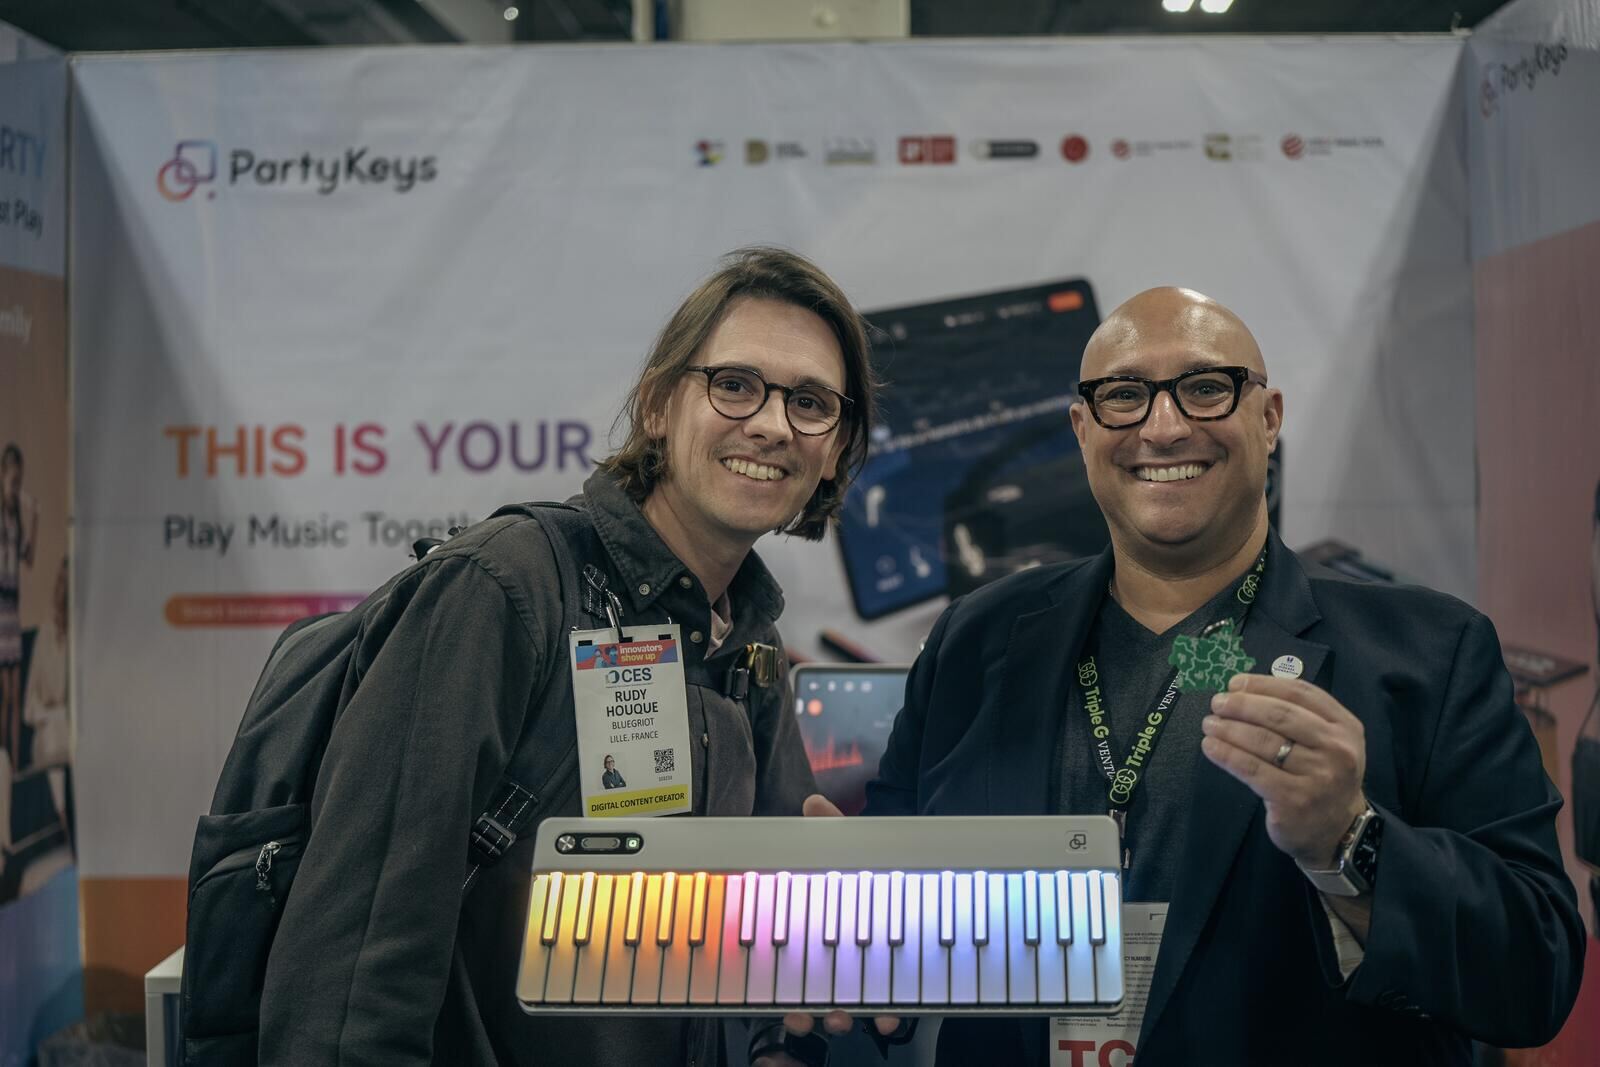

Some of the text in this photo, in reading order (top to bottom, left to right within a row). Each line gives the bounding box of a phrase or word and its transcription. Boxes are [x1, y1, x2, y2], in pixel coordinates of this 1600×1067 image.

[229, 146, 438, 195] PartyKeys
[163, 420, 594, 479] THIS IS YOUR
[163, 514, 234, 556] Play
[248, 513, 349, 548] Music
[620, 644, 663, 655] innovators
[621, 652, 656, 662] show up
[621, 667, 652, 683] CES
[615, 689, 647, 702] RUDY
[606, 702, 659, 717] HOUQUE
[1085, 686, 1105, 725] Triple
[612, 718, 655, 730] BLUEGRIOT
[631, 731, 659, 741] FRANCE
[1093, 725, 1110, 739] G
[1125, 726, 1157, 767] Triple
[1147, 712, 1163, 726] G
[591, 792, 685, 812] DIGITAL CONTENT CREATOR
